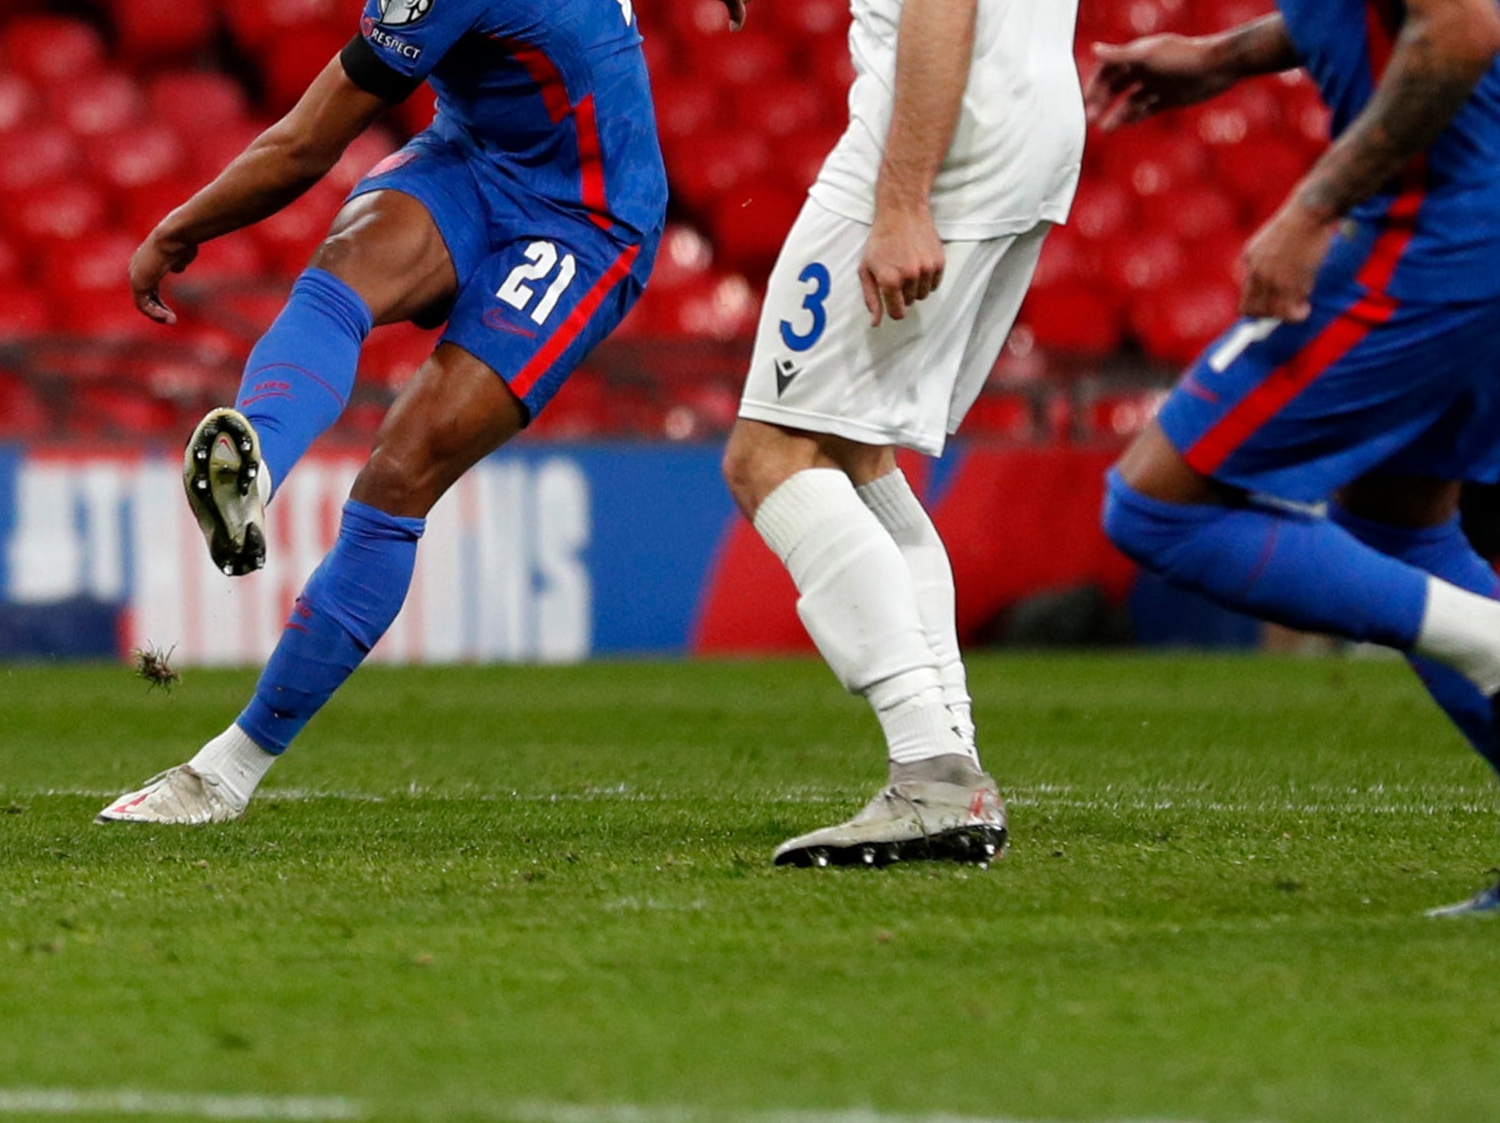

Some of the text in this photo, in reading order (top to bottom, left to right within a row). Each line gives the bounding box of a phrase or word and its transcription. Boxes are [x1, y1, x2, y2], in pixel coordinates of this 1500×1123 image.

[370, 27, 421, 59] RESPECT
[495, 240, 577, 326] 21
[779, 262, 832, 352] 3
